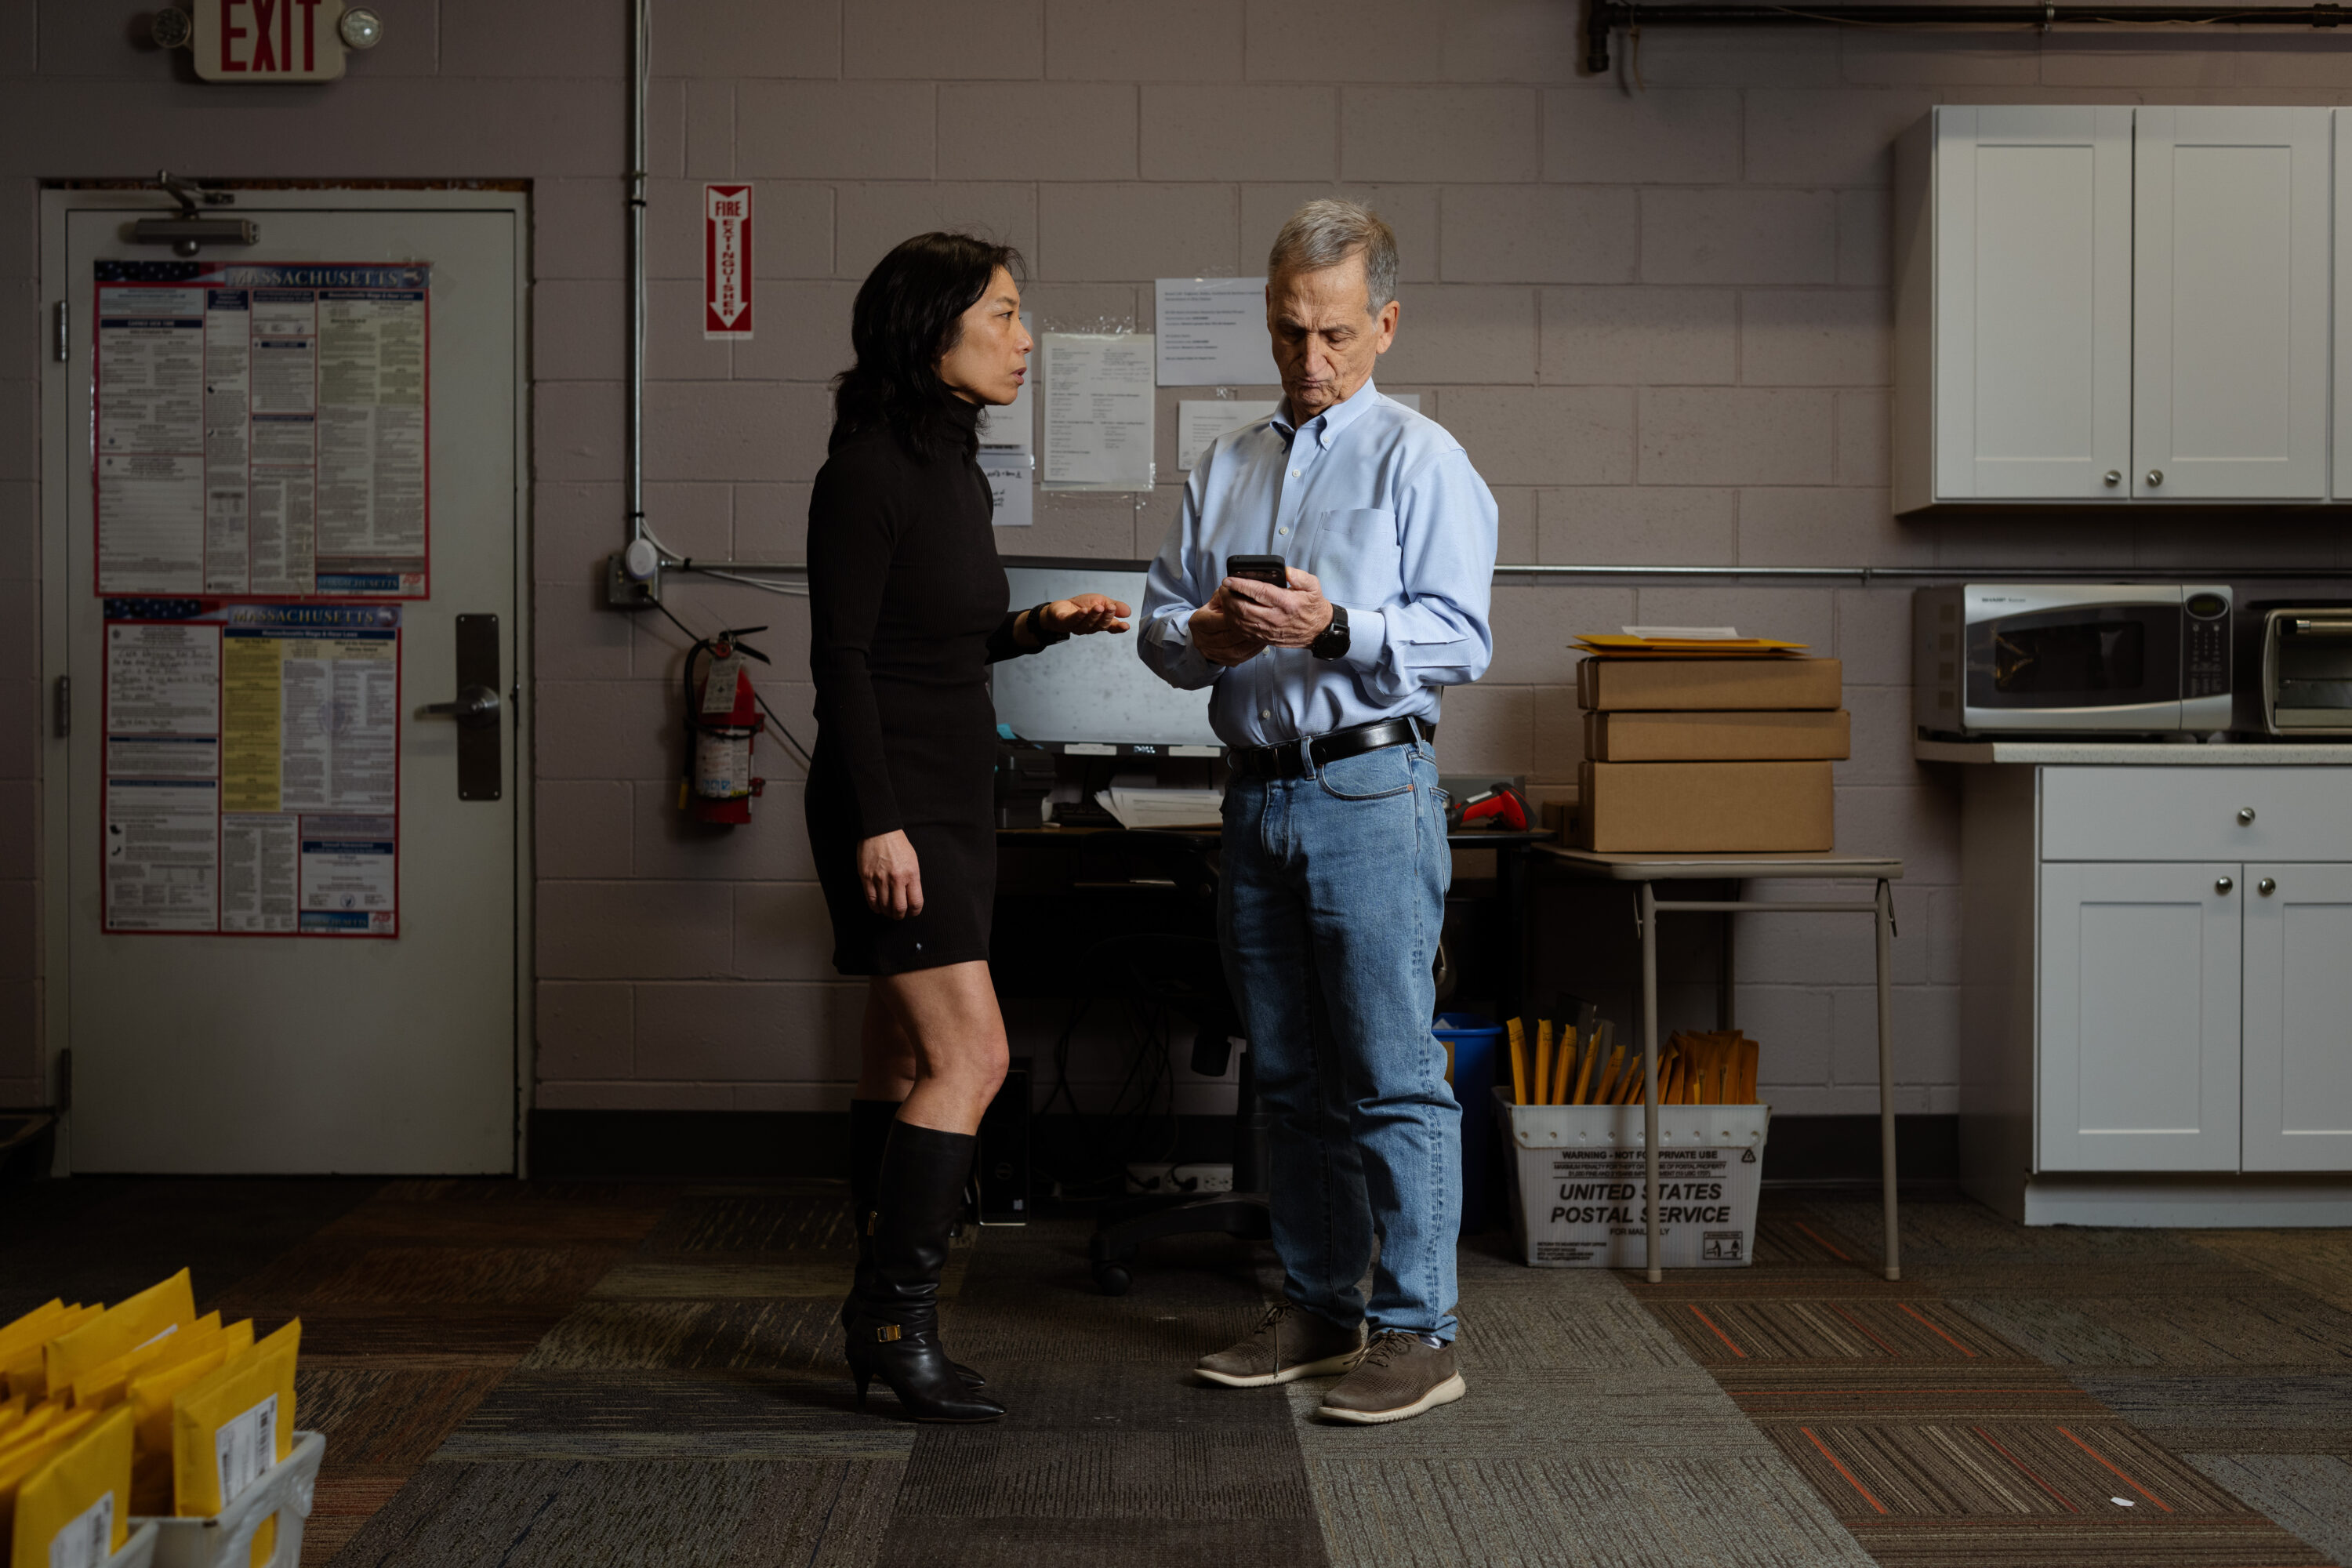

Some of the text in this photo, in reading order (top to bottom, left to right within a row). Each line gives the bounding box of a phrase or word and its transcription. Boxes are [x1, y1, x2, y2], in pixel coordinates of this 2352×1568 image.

[220, 0, 322, 72] EXIT
[715, 201, 742, 216] FIRE
[721, 218, 735, 317] EXTINGUISHER
[231, 269, 398, 286] MASSACHUSETTS
[233, 609, 375, 623] MASSACHUSETTS
[1563, 1151, 1607, 1160] WARNING
[1614, 1151, 1634, 1160] NOT
[1636, 1151, 1646, 1160] FO
[1658, 1151, 1697, 1160] PRIVATE
[1699, 1151, 1718, 1160] USE
[1559, 1183, 1636, 1201] UNITED
[1551, 1207, 1633, 1224] POSTAL
